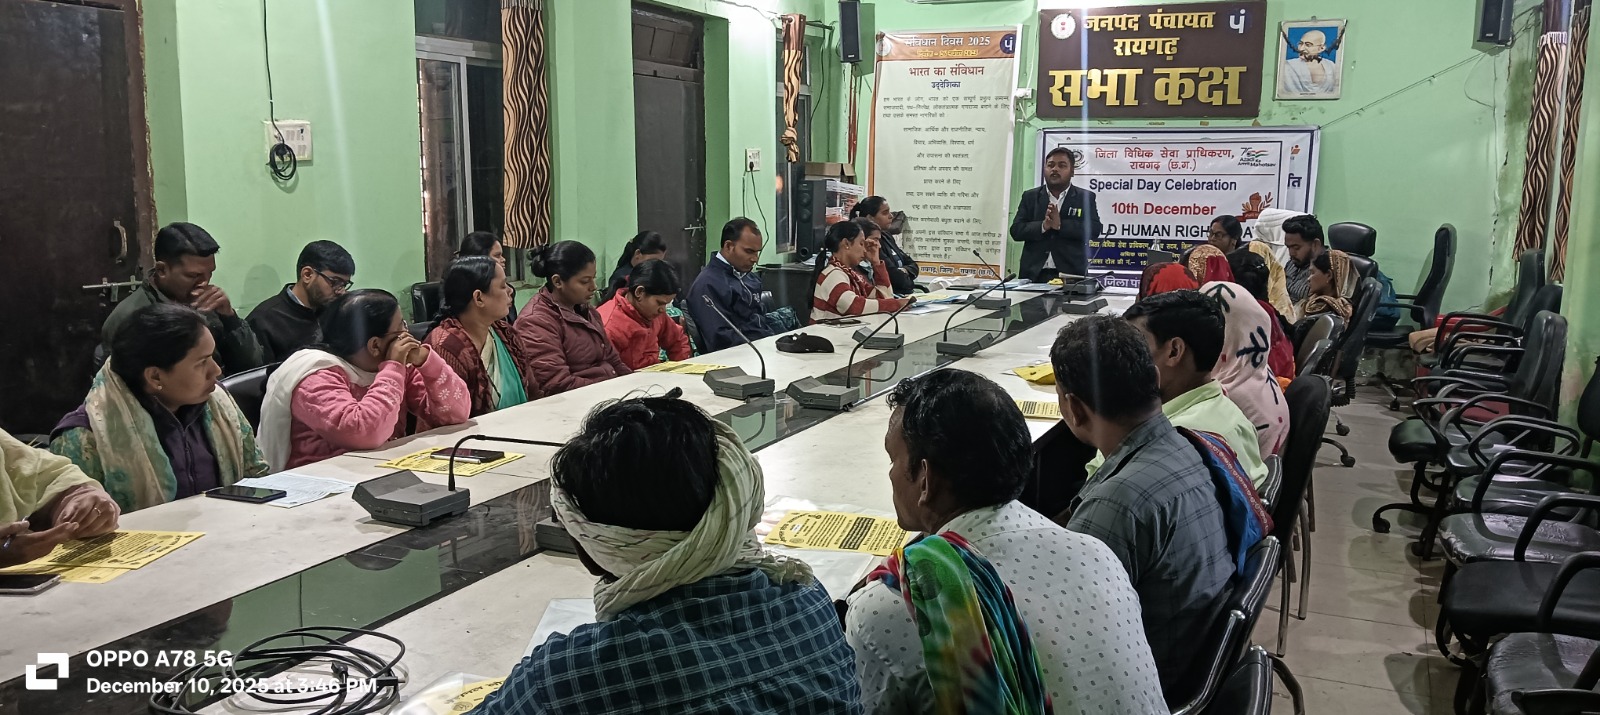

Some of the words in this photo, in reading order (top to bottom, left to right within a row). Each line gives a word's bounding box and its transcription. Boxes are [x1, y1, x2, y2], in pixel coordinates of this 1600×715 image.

[1149, 8, 1216, 29] पंचायत
[941, 35, 963, 46] दिवस
[968, 36, 991, 46] 2025
[1113, 37, 1180, 60] रायगढ़
[909, 67, 930, 76] भारत
[934, 67, 946, 76] का
[950, 63, 985, 75] संविधान
[1049, 68, 1144, 107] सभा
[1152, 66, 1247, 106] कक्ष
[1095, 147, 1118, 159] जिला
[1124, 146, 1154, 159] विधिक
[1160, 146, 1179, 158] सेवा
[1186, 146, 1235, 159] प्राधिकरण,
[1089, 178, 1133, 192] Special
[1137, 178, 1161, 192] Day
[1164, 178, 1237, 191] Celebration
[1111, 202, 1139, 215] 10th
[1143, 203, 1217, 216] December
[1121, 224, 1171, 238] HUMAN
[1175, 225, 1211, 238] RIGH
[1103, 275, 1128, 287] जिला
